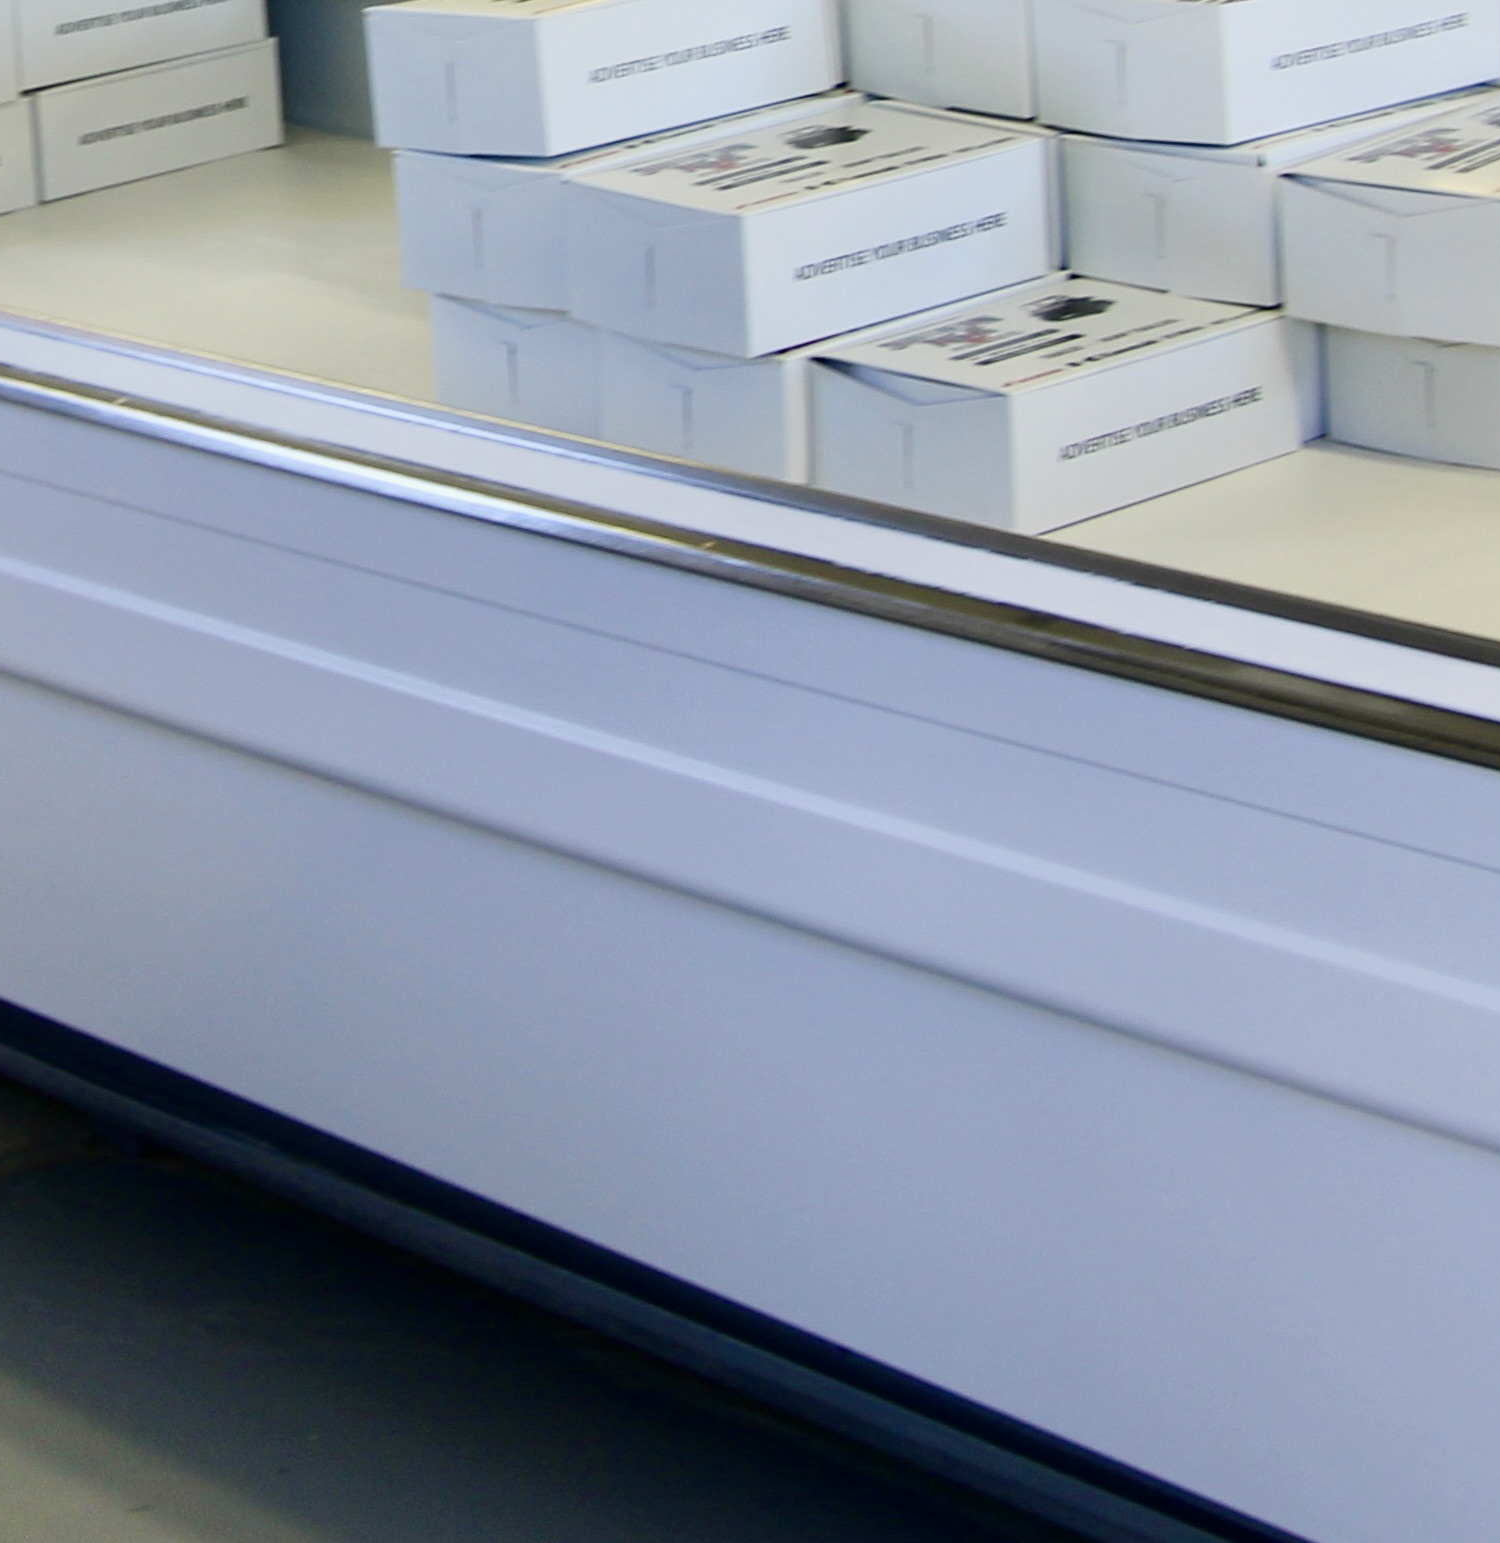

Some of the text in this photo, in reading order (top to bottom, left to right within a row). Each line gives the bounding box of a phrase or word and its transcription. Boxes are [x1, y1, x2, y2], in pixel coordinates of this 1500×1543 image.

[589, 26, 790, 84] ADVERTISE YOUR BUSINESS HERE
[1270, 12, 1469, 71] ADVERTISE YOUR BUSINESS HERE
[792, 212, 1007, 281] ADVERTISE YOUR BUSINESS HERE
[1057, 386, 1264, 462] ADVERTISE YOUR BUSINESS HERE
